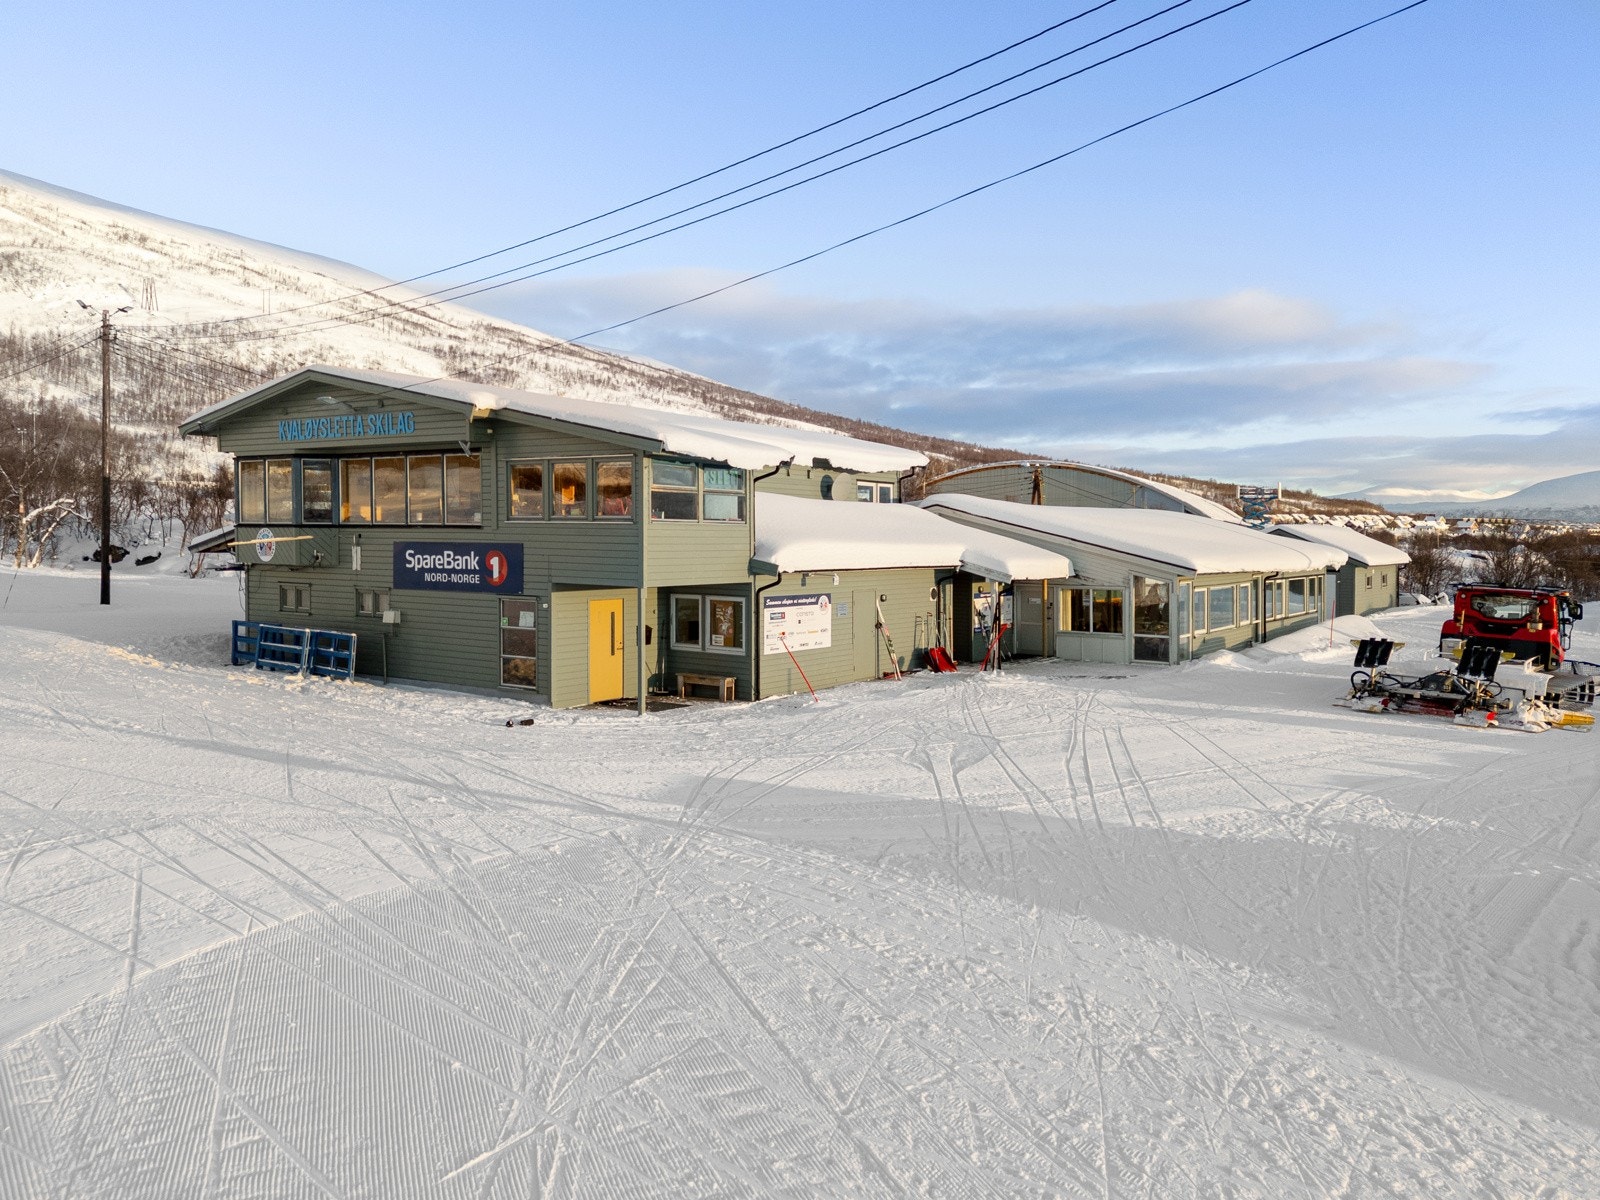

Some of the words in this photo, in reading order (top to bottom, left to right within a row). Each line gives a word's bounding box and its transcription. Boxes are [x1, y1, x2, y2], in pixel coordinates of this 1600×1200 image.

[279, 415, 364, 441] KVALØYSLETTA
[367, 411, 416, 437] SKILAG
[405, 550, 480, 571] SpareBank
[424, 572, 480, 584] NORD-NORGE
